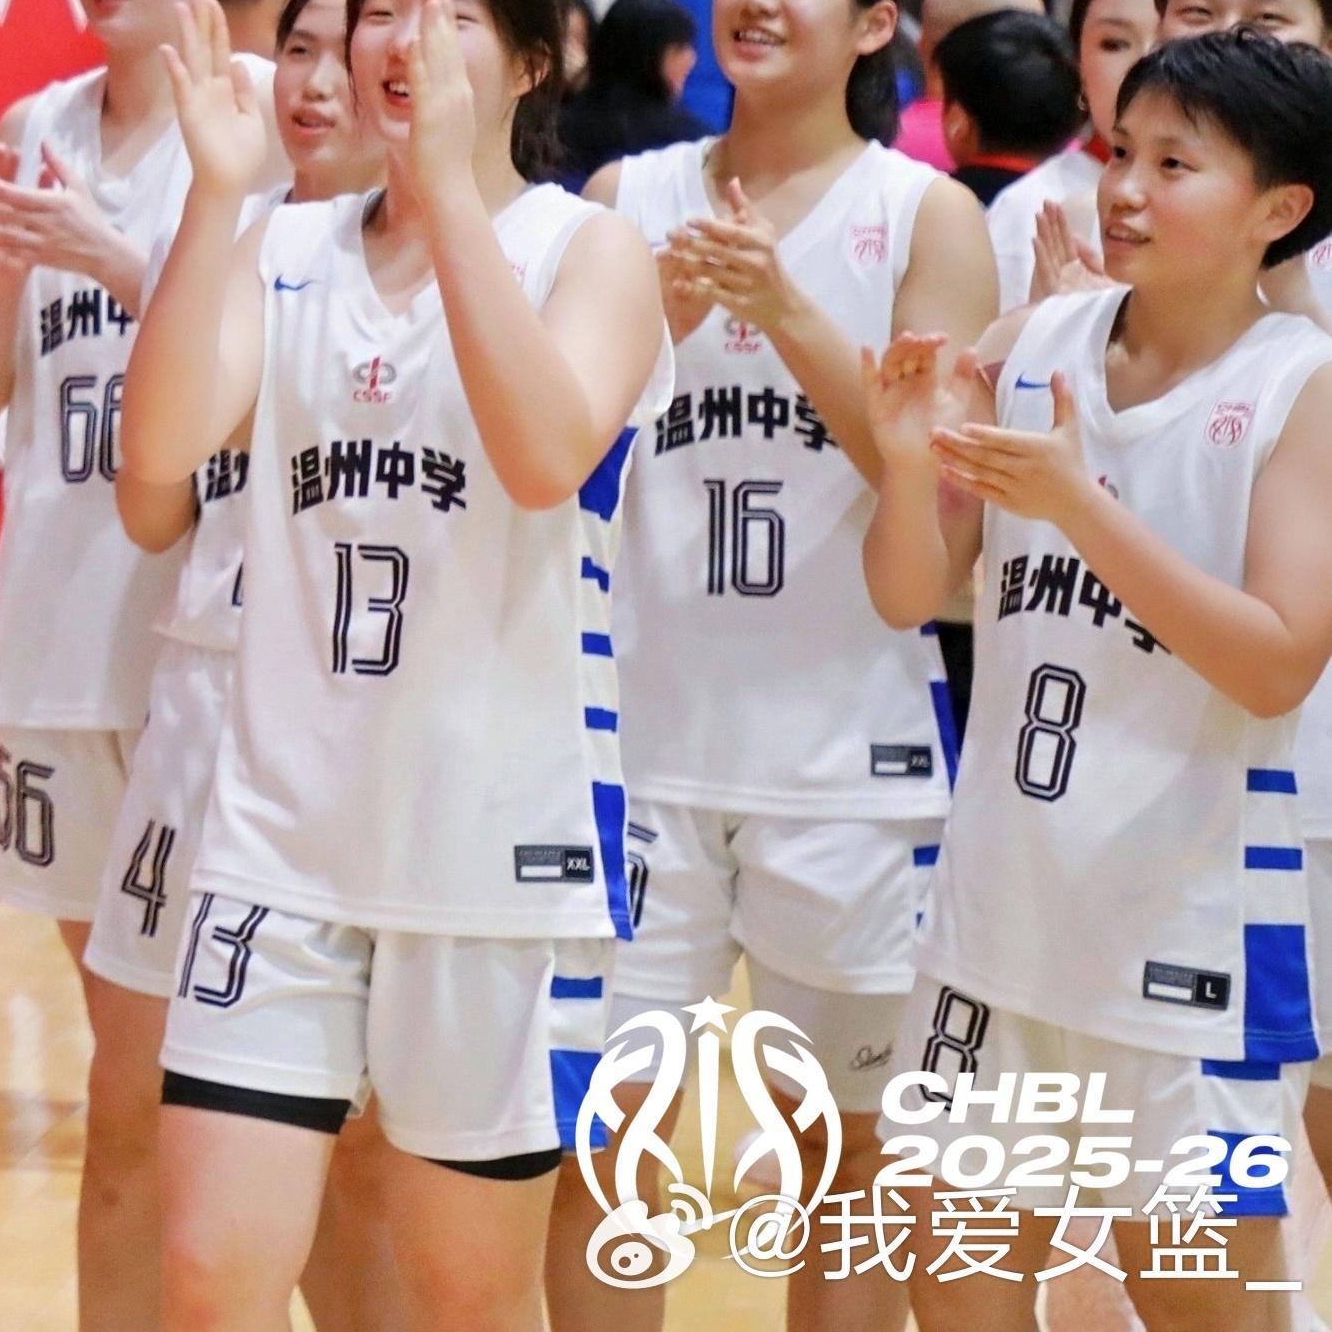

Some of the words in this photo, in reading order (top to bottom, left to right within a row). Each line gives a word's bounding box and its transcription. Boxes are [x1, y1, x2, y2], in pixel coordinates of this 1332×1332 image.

[290, 438, 467, 515] 温州中学
[702, 477, 785, 598] 16
[331, 541, 410, 677] 13
[1013, 661, 1086, 803] 8
[121, 819, 176, 939] 4
[566, 856, 592, 872] XXL
[178, 892, 271, 1009] 13
[1205, 981, 1218, 999] L
